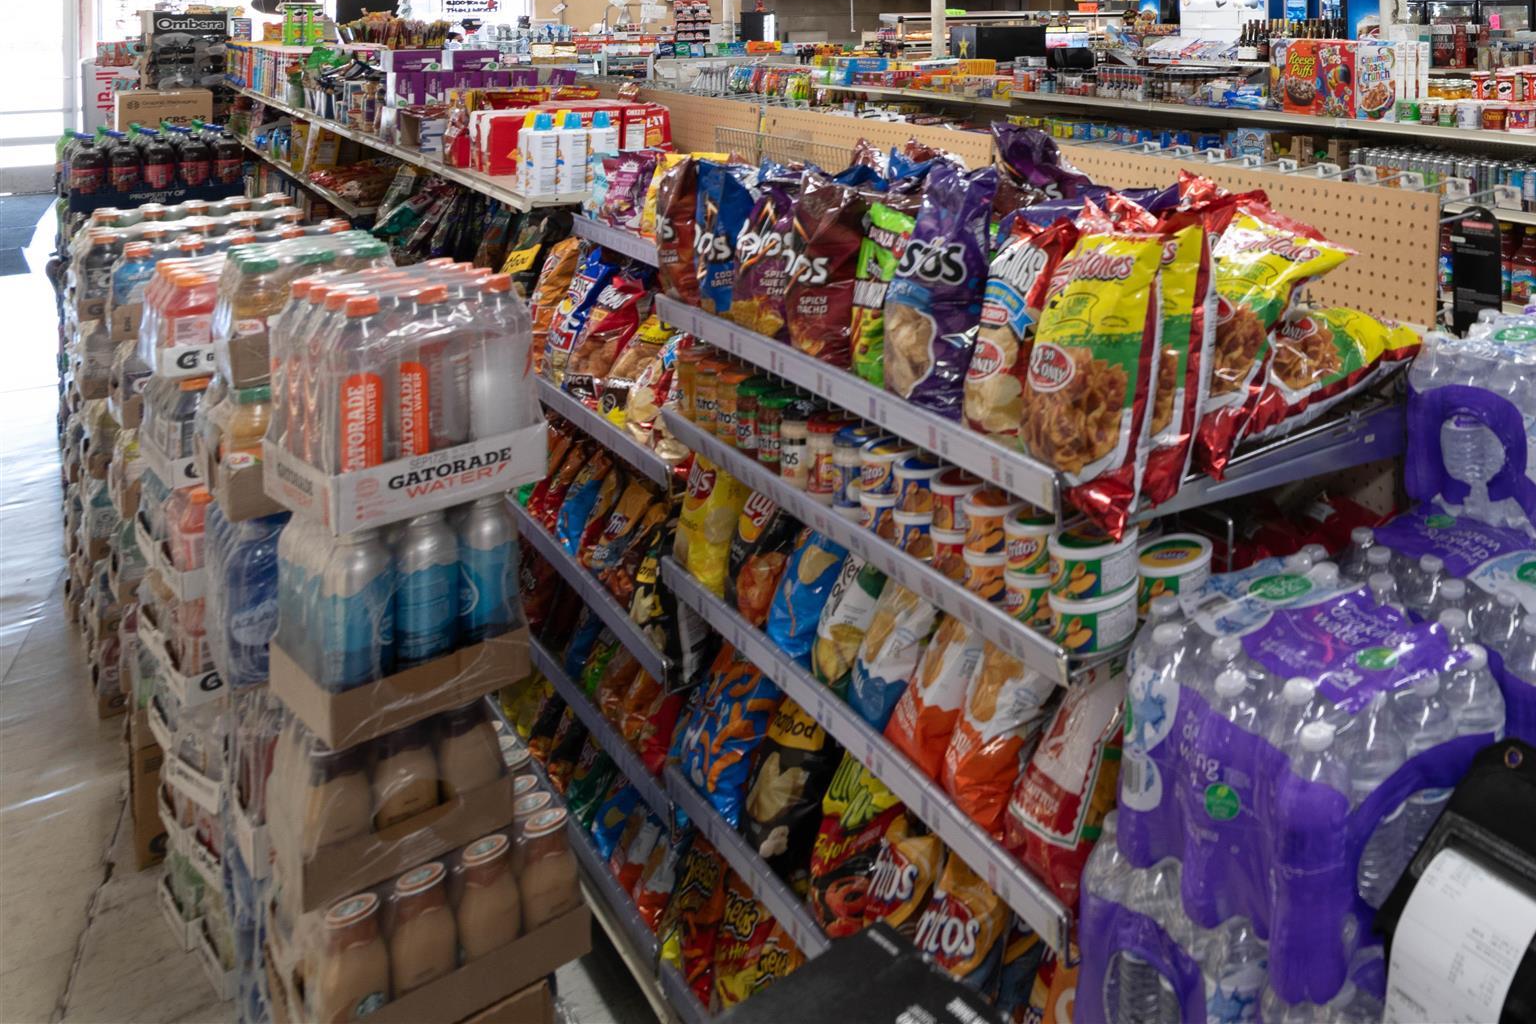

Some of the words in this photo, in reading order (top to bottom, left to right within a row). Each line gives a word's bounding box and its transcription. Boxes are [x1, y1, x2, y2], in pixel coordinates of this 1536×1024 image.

[157, 18, 225, 31] Omberra
[797, 304, 828, 314] NACHO
[800, 296, 828, 305] SPICY
[366, 382, 377, 425] WATER
[413, 371, 422, 412] WATER
[388, 446, 512, 490] GATORADE
[405, 466, 493, 498] WATER
